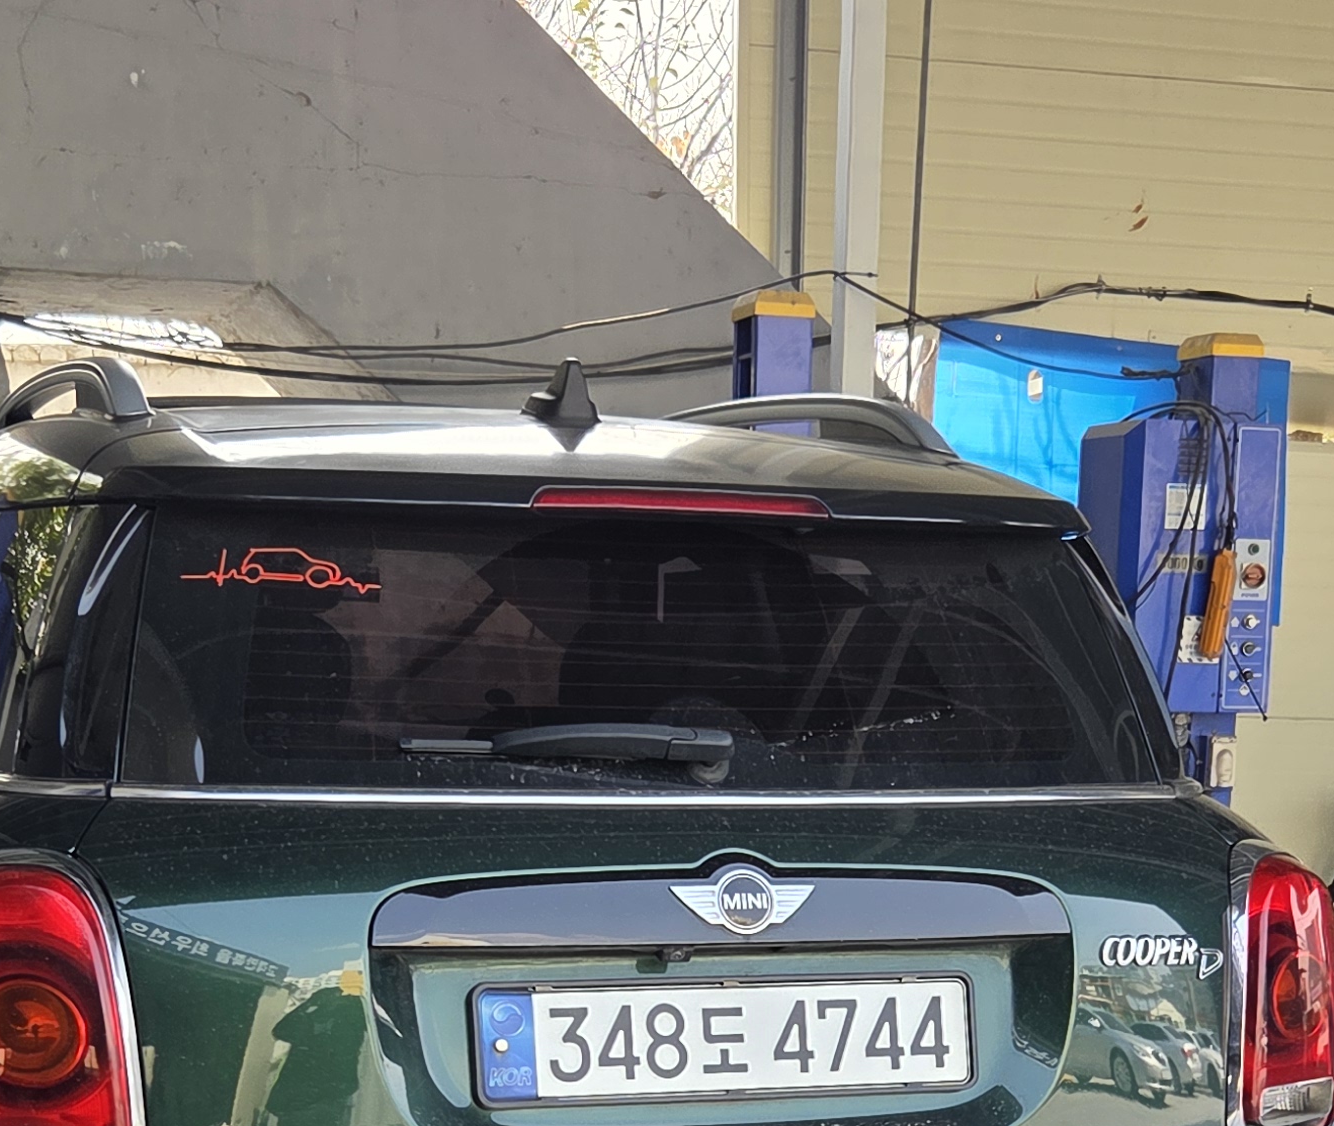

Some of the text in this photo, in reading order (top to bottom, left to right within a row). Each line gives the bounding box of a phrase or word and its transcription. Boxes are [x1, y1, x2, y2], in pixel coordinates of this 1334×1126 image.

[722, 892, 769, 910] MINI
[1101, 935, 1224, 980] COOPER D
[548, 1003, 749, 1082] 348도
[773, 996, 951, 1073] 4744
[489, 1066, 533, 1087] KOR
